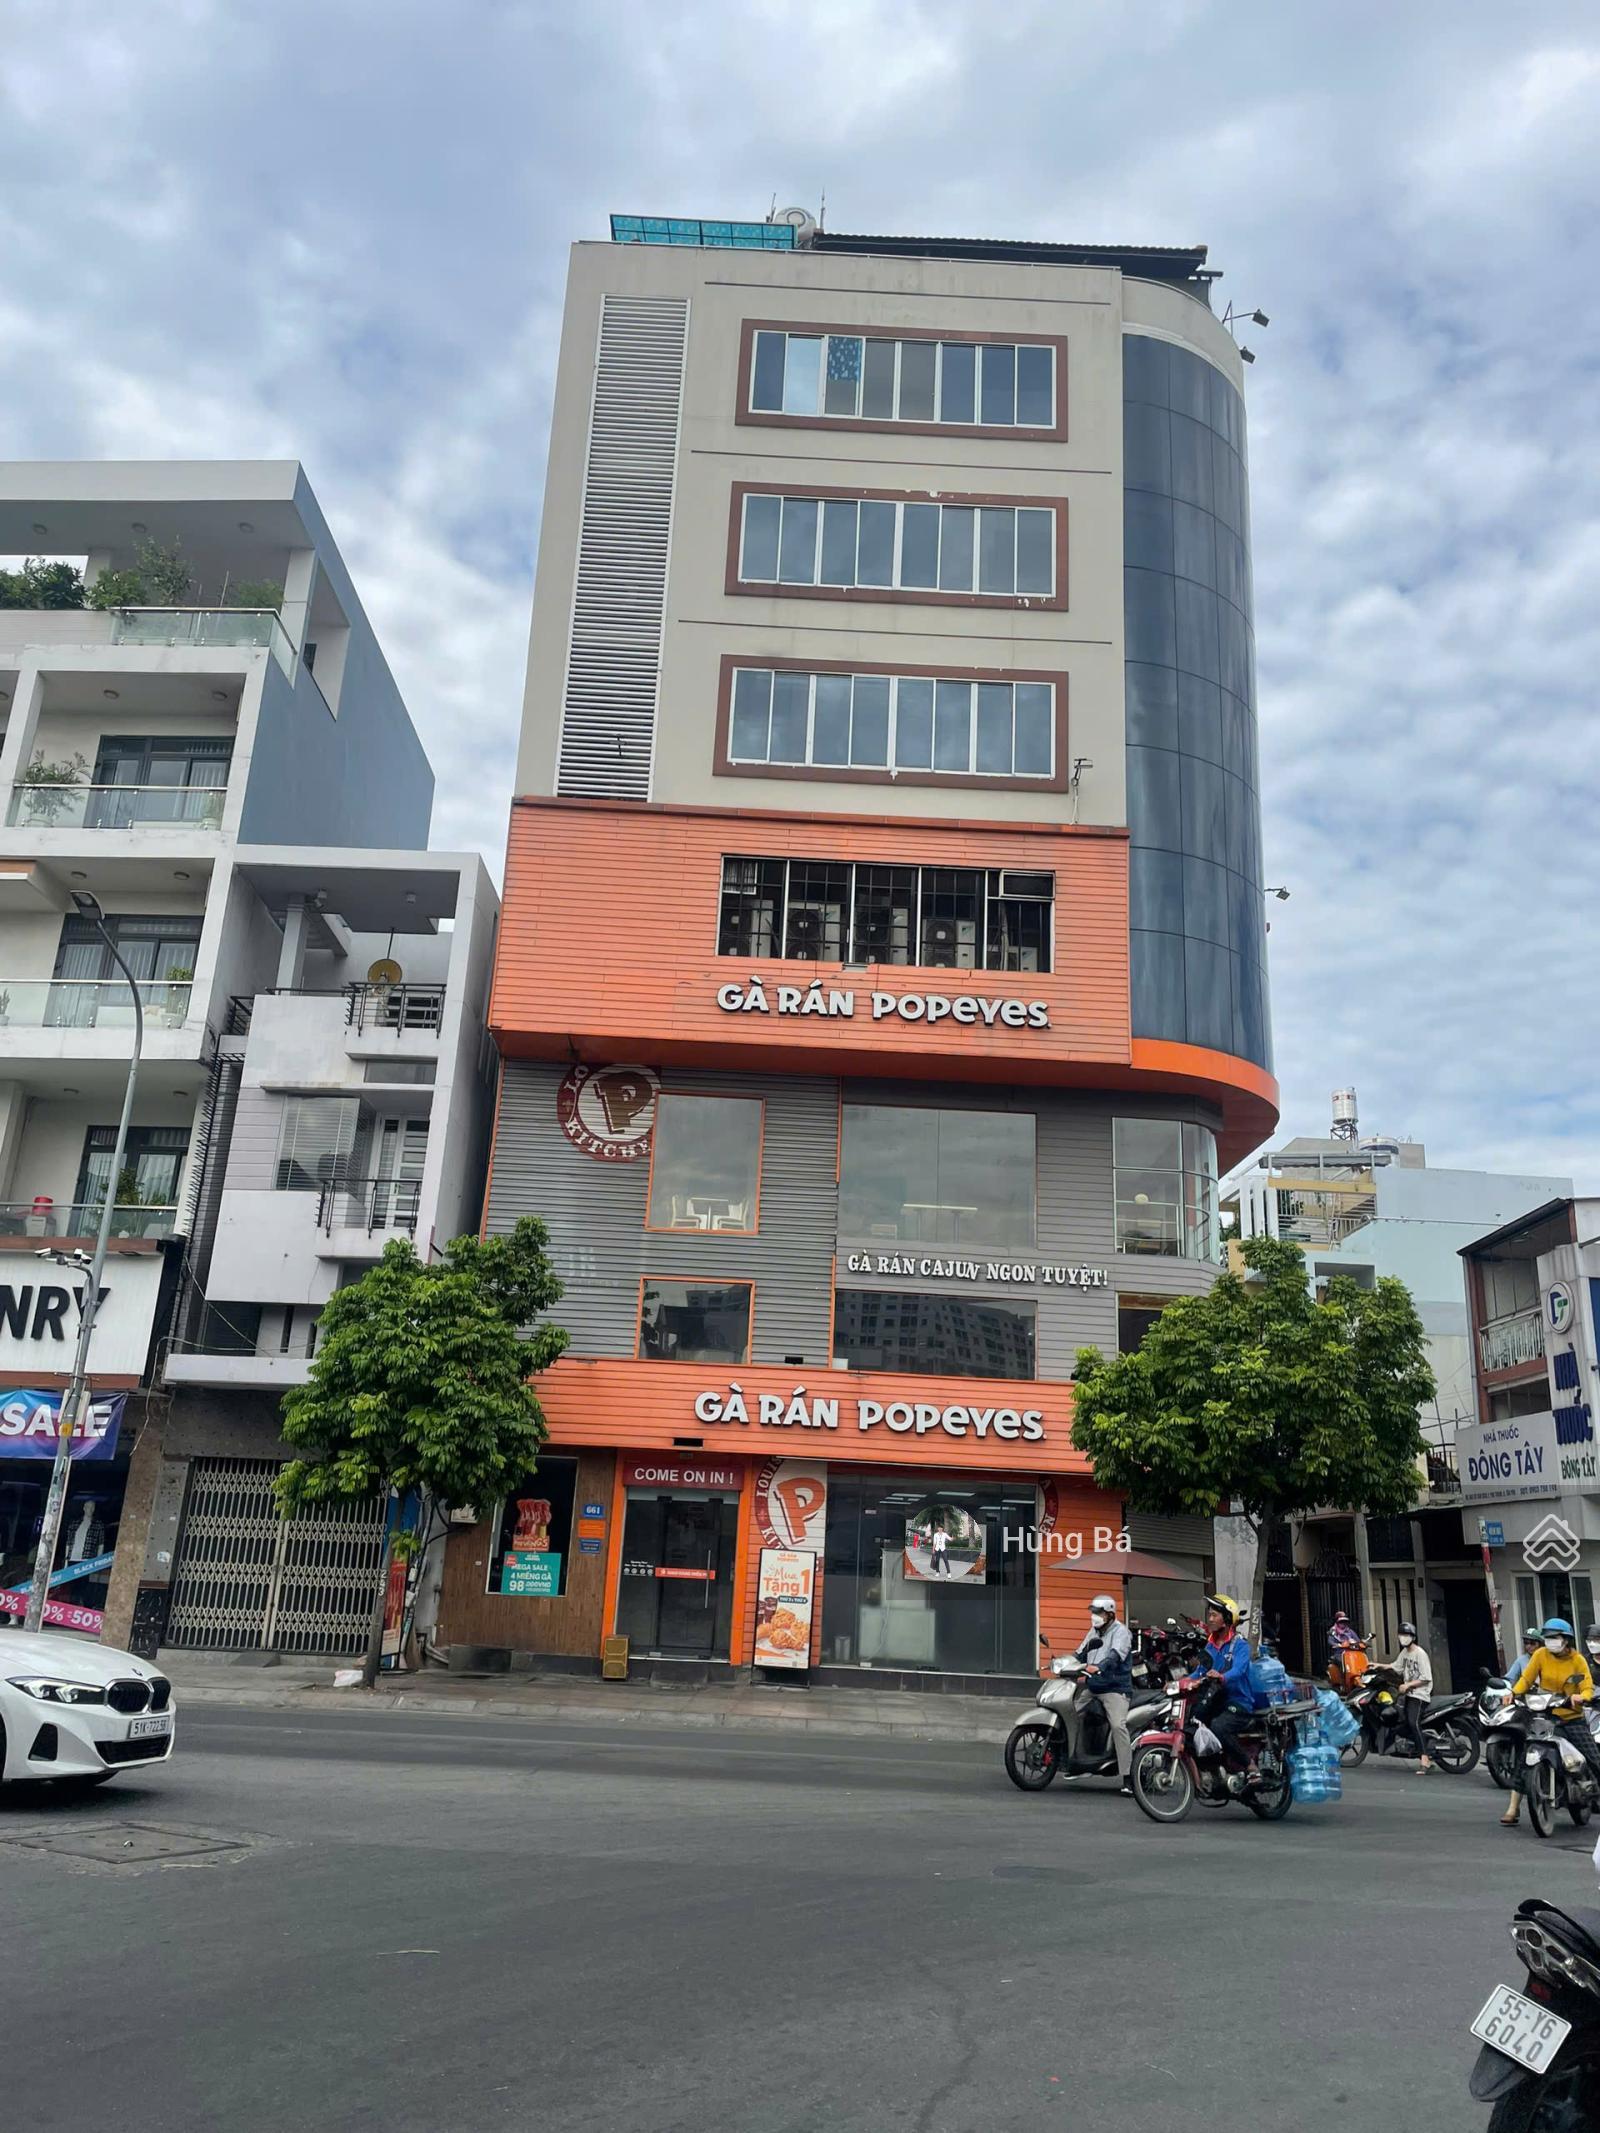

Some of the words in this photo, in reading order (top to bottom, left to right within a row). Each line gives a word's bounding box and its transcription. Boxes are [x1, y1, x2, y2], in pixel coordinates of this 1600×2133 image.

[717, 975, 769, 1013] GÀ
[777, 979, 854, 1017] RÁN
[848, 1250, 872, 1273] GÀ
[877, 1252, 915, 1275] RÁN
[920, 1259, 980, 1280] CAJUN
[986, 1263, 1037, 1283] NGON
[1042, 1263, 1108, 1292] TUYỆT!
[0, 1403, 112, 1438] SAE
[695, 1382, 749, 1424] GÀ
[759, 1385, 838, 1428] RÁN
[1483, 1428, 1497, 1443] NHÀ
[1497, 1424, 1519, 1440] THUỐC
[634, 1468, 679, 1481] COME
[683, 1470, 705, 1482] ON
[710, 1472, 724, 1484] IN
[1468, 1449, 1511, 1481] ĐÔNG
[1515, 1441, 1544, 1475] TÂY
[586, 1506, 600, 1515] 661
[509, 1580, 525, 1592] 98
[763, 1577, 800, 1596] Tặng
[1485, 2016, 1544, 2063] 6040
